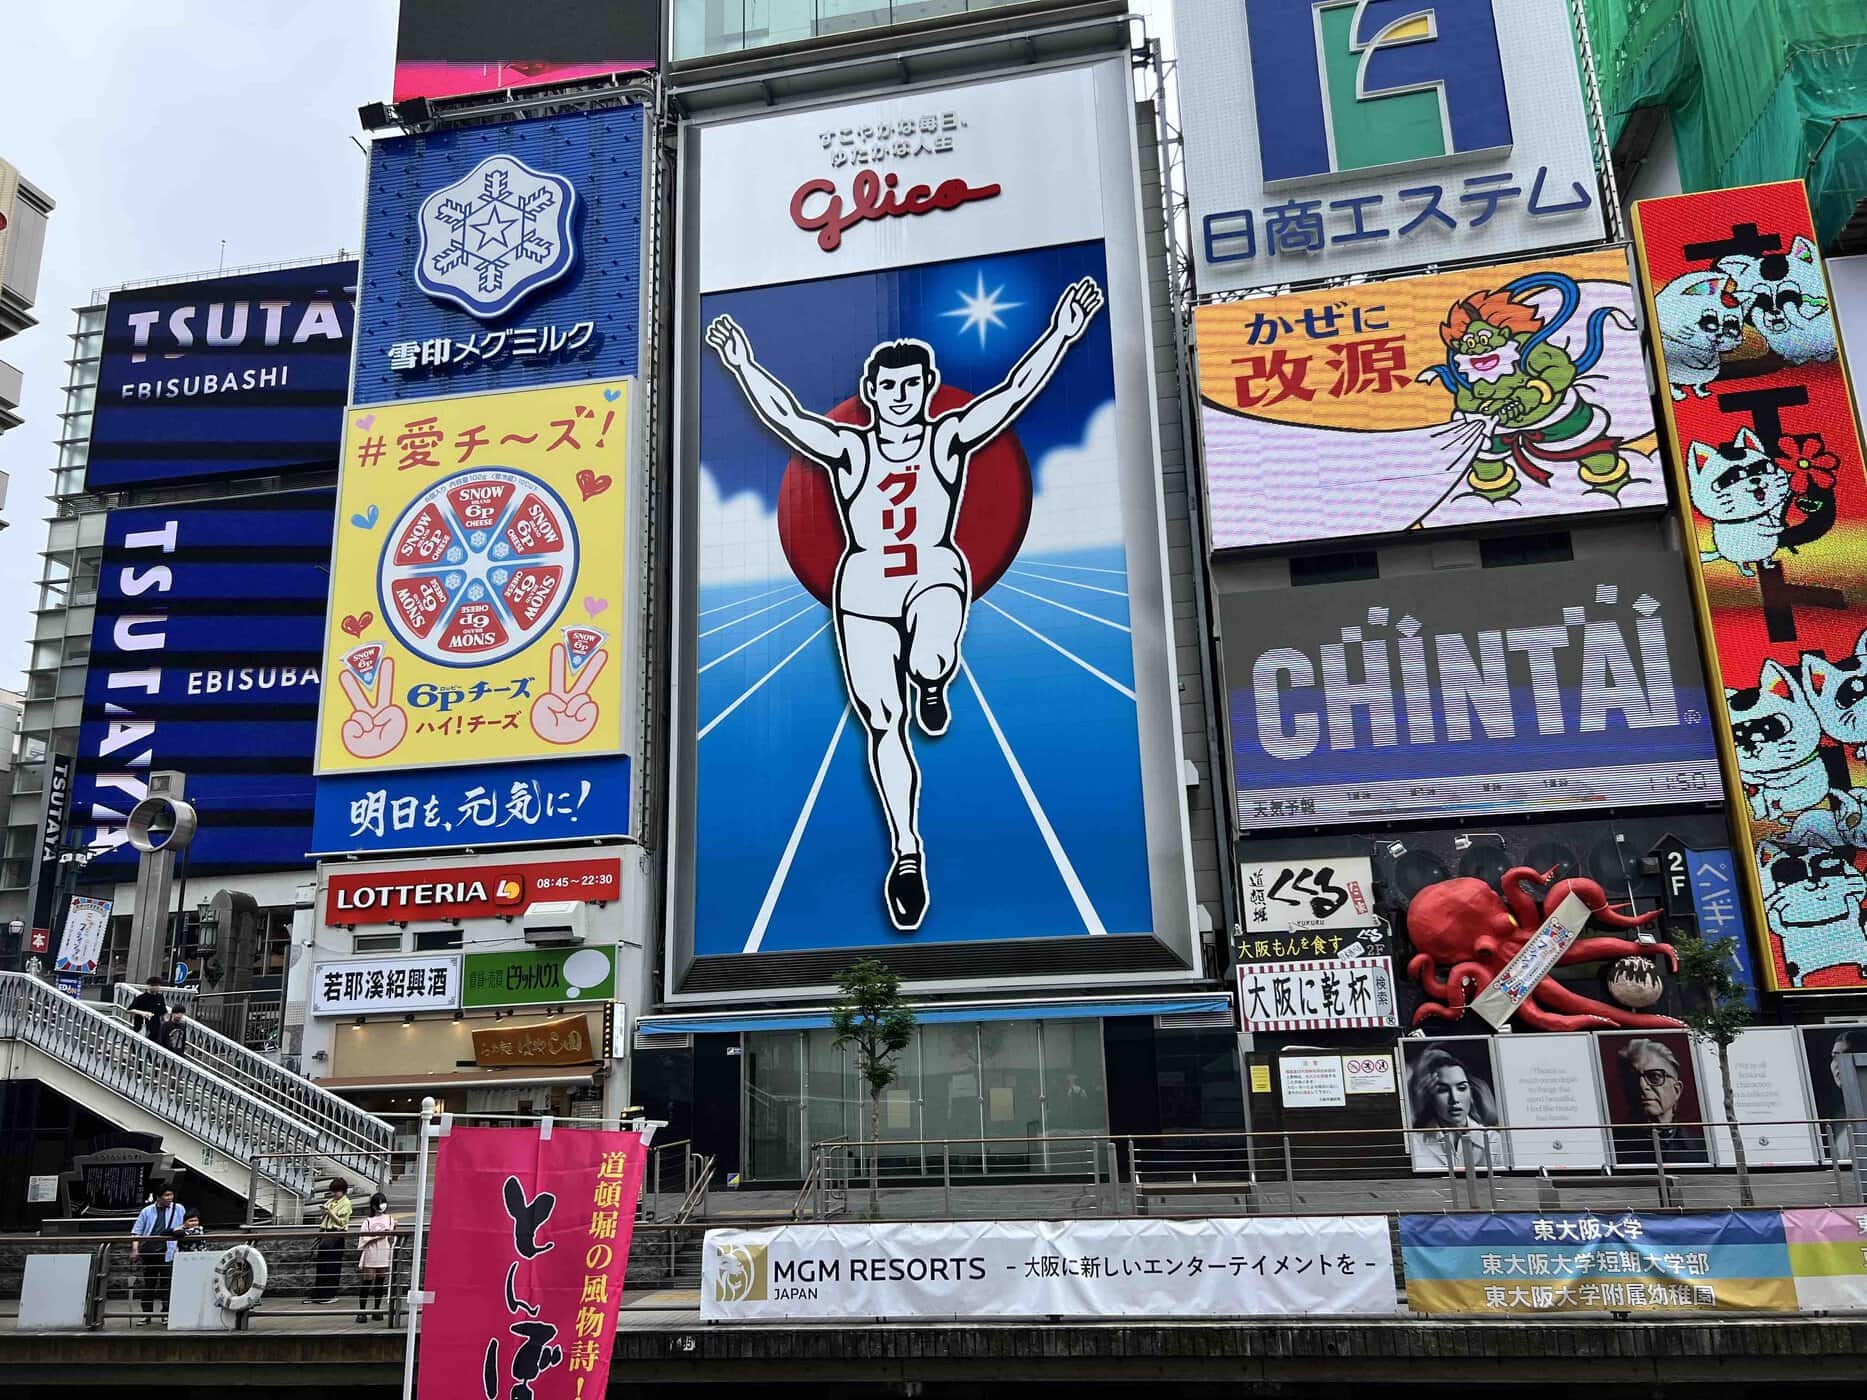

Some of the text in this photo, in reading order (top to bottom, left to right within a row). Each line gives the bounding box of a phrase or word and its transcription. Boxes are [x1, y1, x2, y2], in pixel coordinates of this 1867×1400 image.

[832, 136, 954, 168] ゆたかな人生
[1203, 166, 1592, 264] 日商エステム
[128, 287, 357, 363] TSUTA
[1244, 301, 1389, 346] かぜに
[388, 321, 594, 370] 雪印メグミルク
[121, 366, 288, 400] EBISUBASHI
[1231, 334, 1413, 408] 改源
[460, 486, 504, 501] SNOW
[401, 512, 432, 556] SNOW
[466, 518, 493, 527] CHEESE
[528, 504, 559, 543] SNOW
[877, 465, 920, 578] グリコ
[432, 535, 450, 560] CHEESE
[507, 529, 524, 553] CHEESE
[430, 579, 447, 602] CHEESE
[503, 571, 523, 596] CHEESE
[524, 575, 555, 620] SNOW
[397, 588, 425, 627] SNOW
[449, 632, 495, 648] SNOW
[87, 520, 178, 857] TSUTAYA
[1252, 585, 1680, 760] CHINTAI
[42, 763, 70, 861] TSUTAYA
[337, 880, 488, 910] LOTTERIA
[1267, 867, 1348, 919] くくる
[1248, 971, 1372, 1019] 大阪に乾杯
[1532, 1217, 1643, 1241] 東大阪大学
[774, 1256, 986, 1283] MGM RESORTS
[1024, 1252, 1356, 1279] 大阪に新しいエンターテイメントを
[1480, 1251, 1711, 1276] 東大阪大学短期大学部
[774, 1287, 818, 1300] JAPAN
[1485, 1284, 1717, 1309] 東大阪大学附属幼稚園
